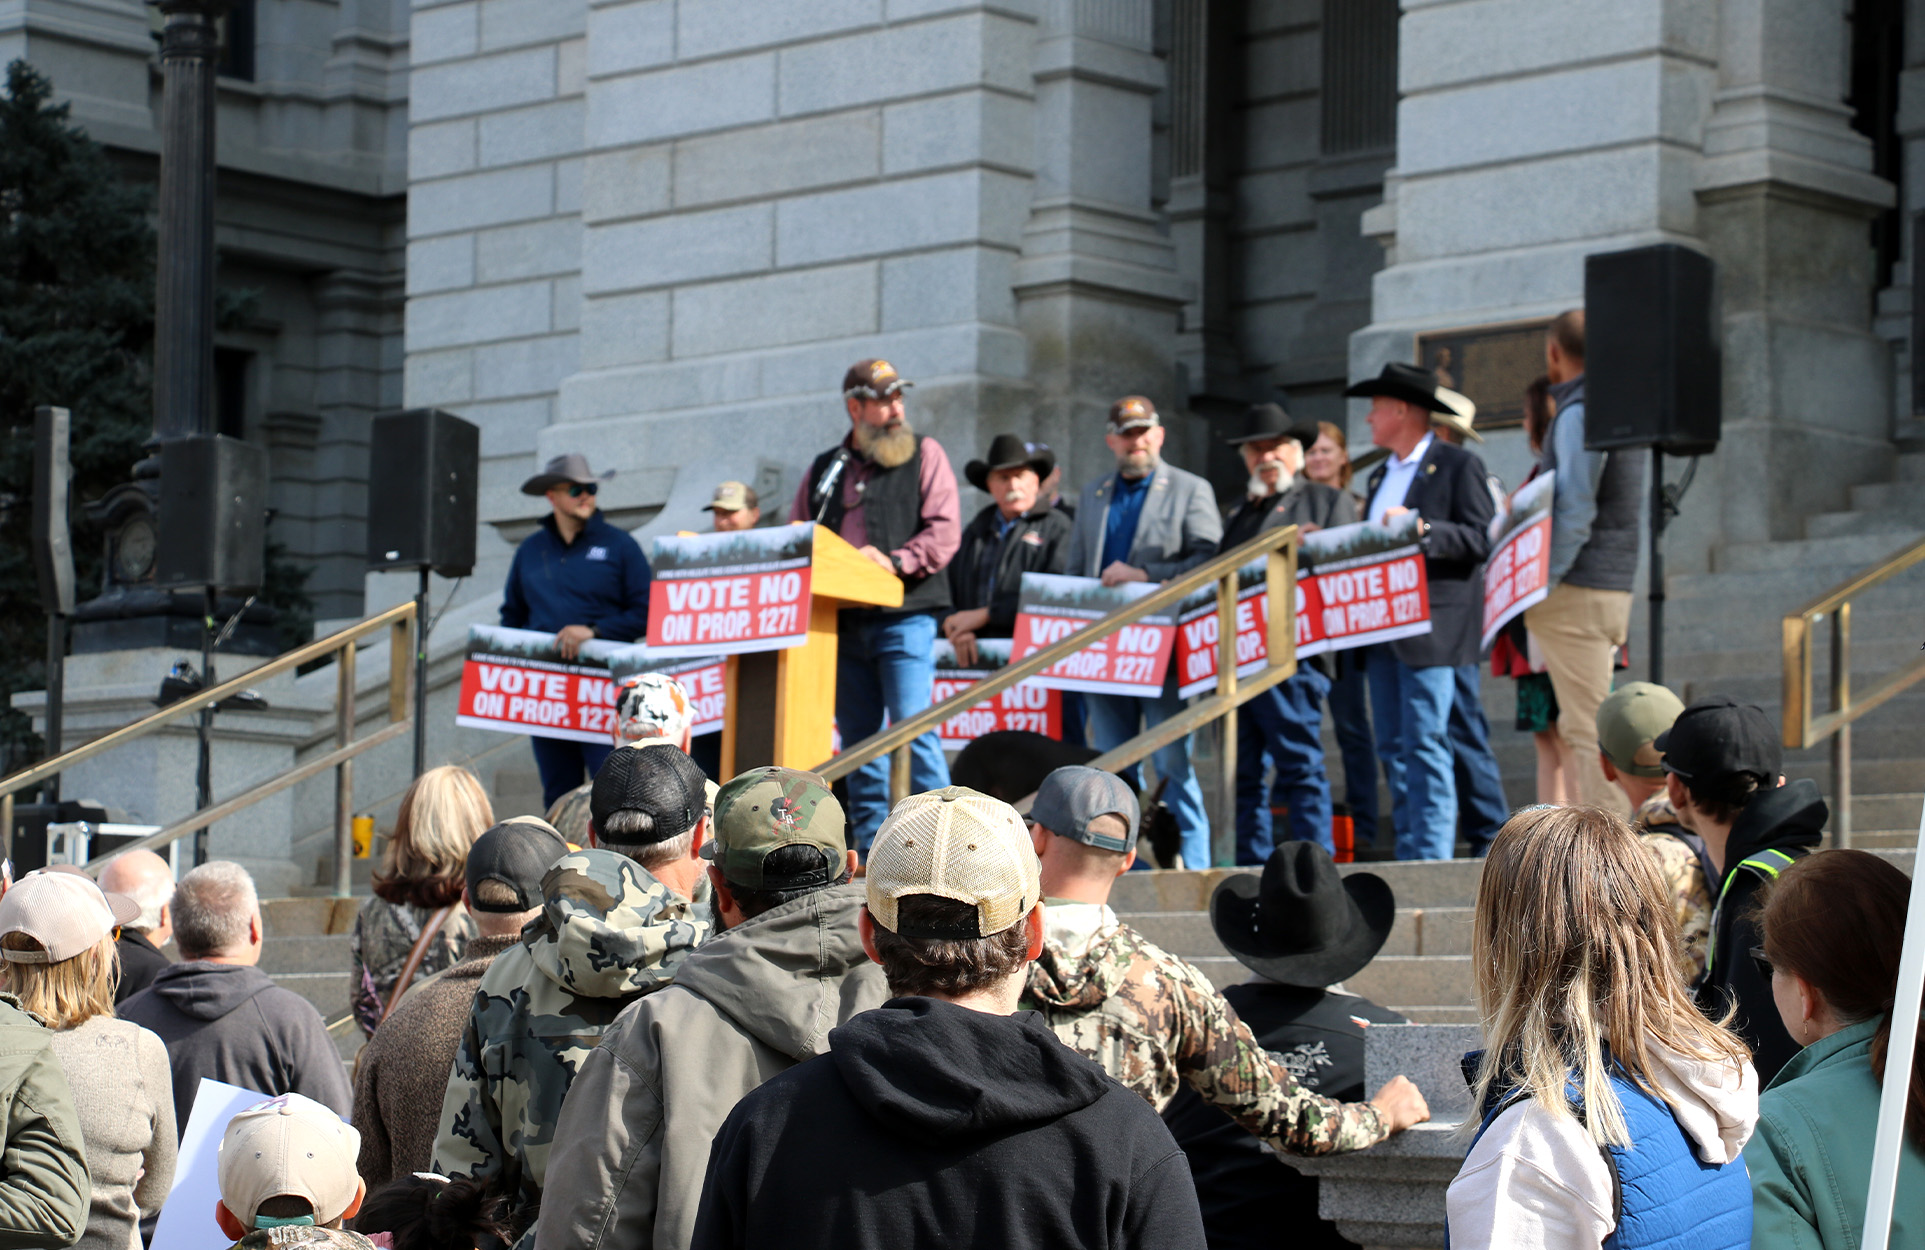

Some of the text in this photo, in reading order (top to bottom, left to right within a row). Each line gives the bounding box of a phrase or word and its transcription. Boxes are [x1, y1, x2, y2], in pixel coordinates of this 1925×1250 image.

[666, 572, 801, 612] VOTE NO
[1317, 566, 1384, 606] VOTE
[1387, 558, 1419, 593] NO
[661, 603, 798, 643] ON PROP. 127!
[1184, 600, 1255, 651] VOE
[1322, 606, 1346, 637] ON
[1347, 598, 1391, 632] PROP.
[1391, 590, 1422, 624] 127!
[1116, 625, 1162, 654] NO
[478, 664, 568, 700] VOTE
[1053, 651, 1107, 678] PROP.
[1114, 655, 1156, 682] 127!
[1187, 647, 1212, 681] ON
[473, 690, 505, 718] ON
[508, 695, 571, 727] PROP.
[1001, 683, 1048, 709] NO
